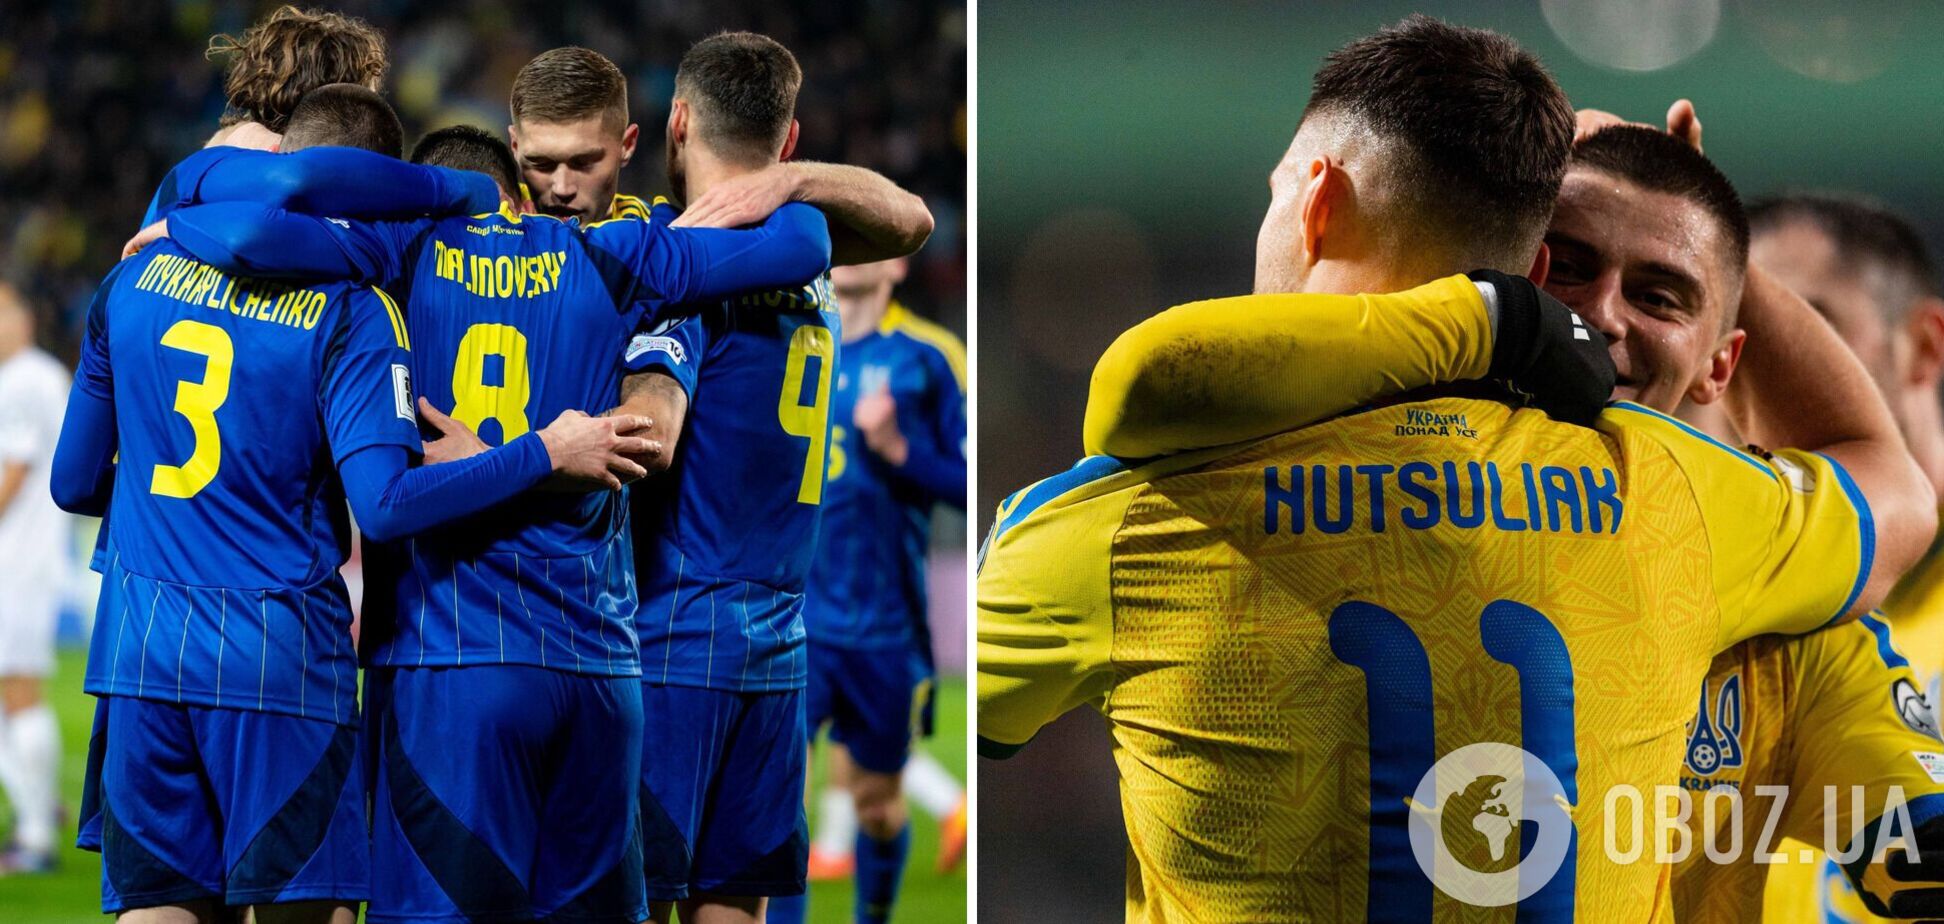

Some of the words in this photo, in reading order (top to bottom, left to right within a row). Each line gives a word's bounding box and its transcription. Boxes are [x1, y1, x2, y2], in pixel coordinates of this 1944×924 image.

[150, 319, 234, 499] 3
[450, 323, 530, 446] 8
[778, 324, 835, 505] 9
[1395, 425, 1450, 437] ПОНАД
[1264, 461, 1624, 534] HUTSULIAK
[1328, 599, 1578, 924] 11
